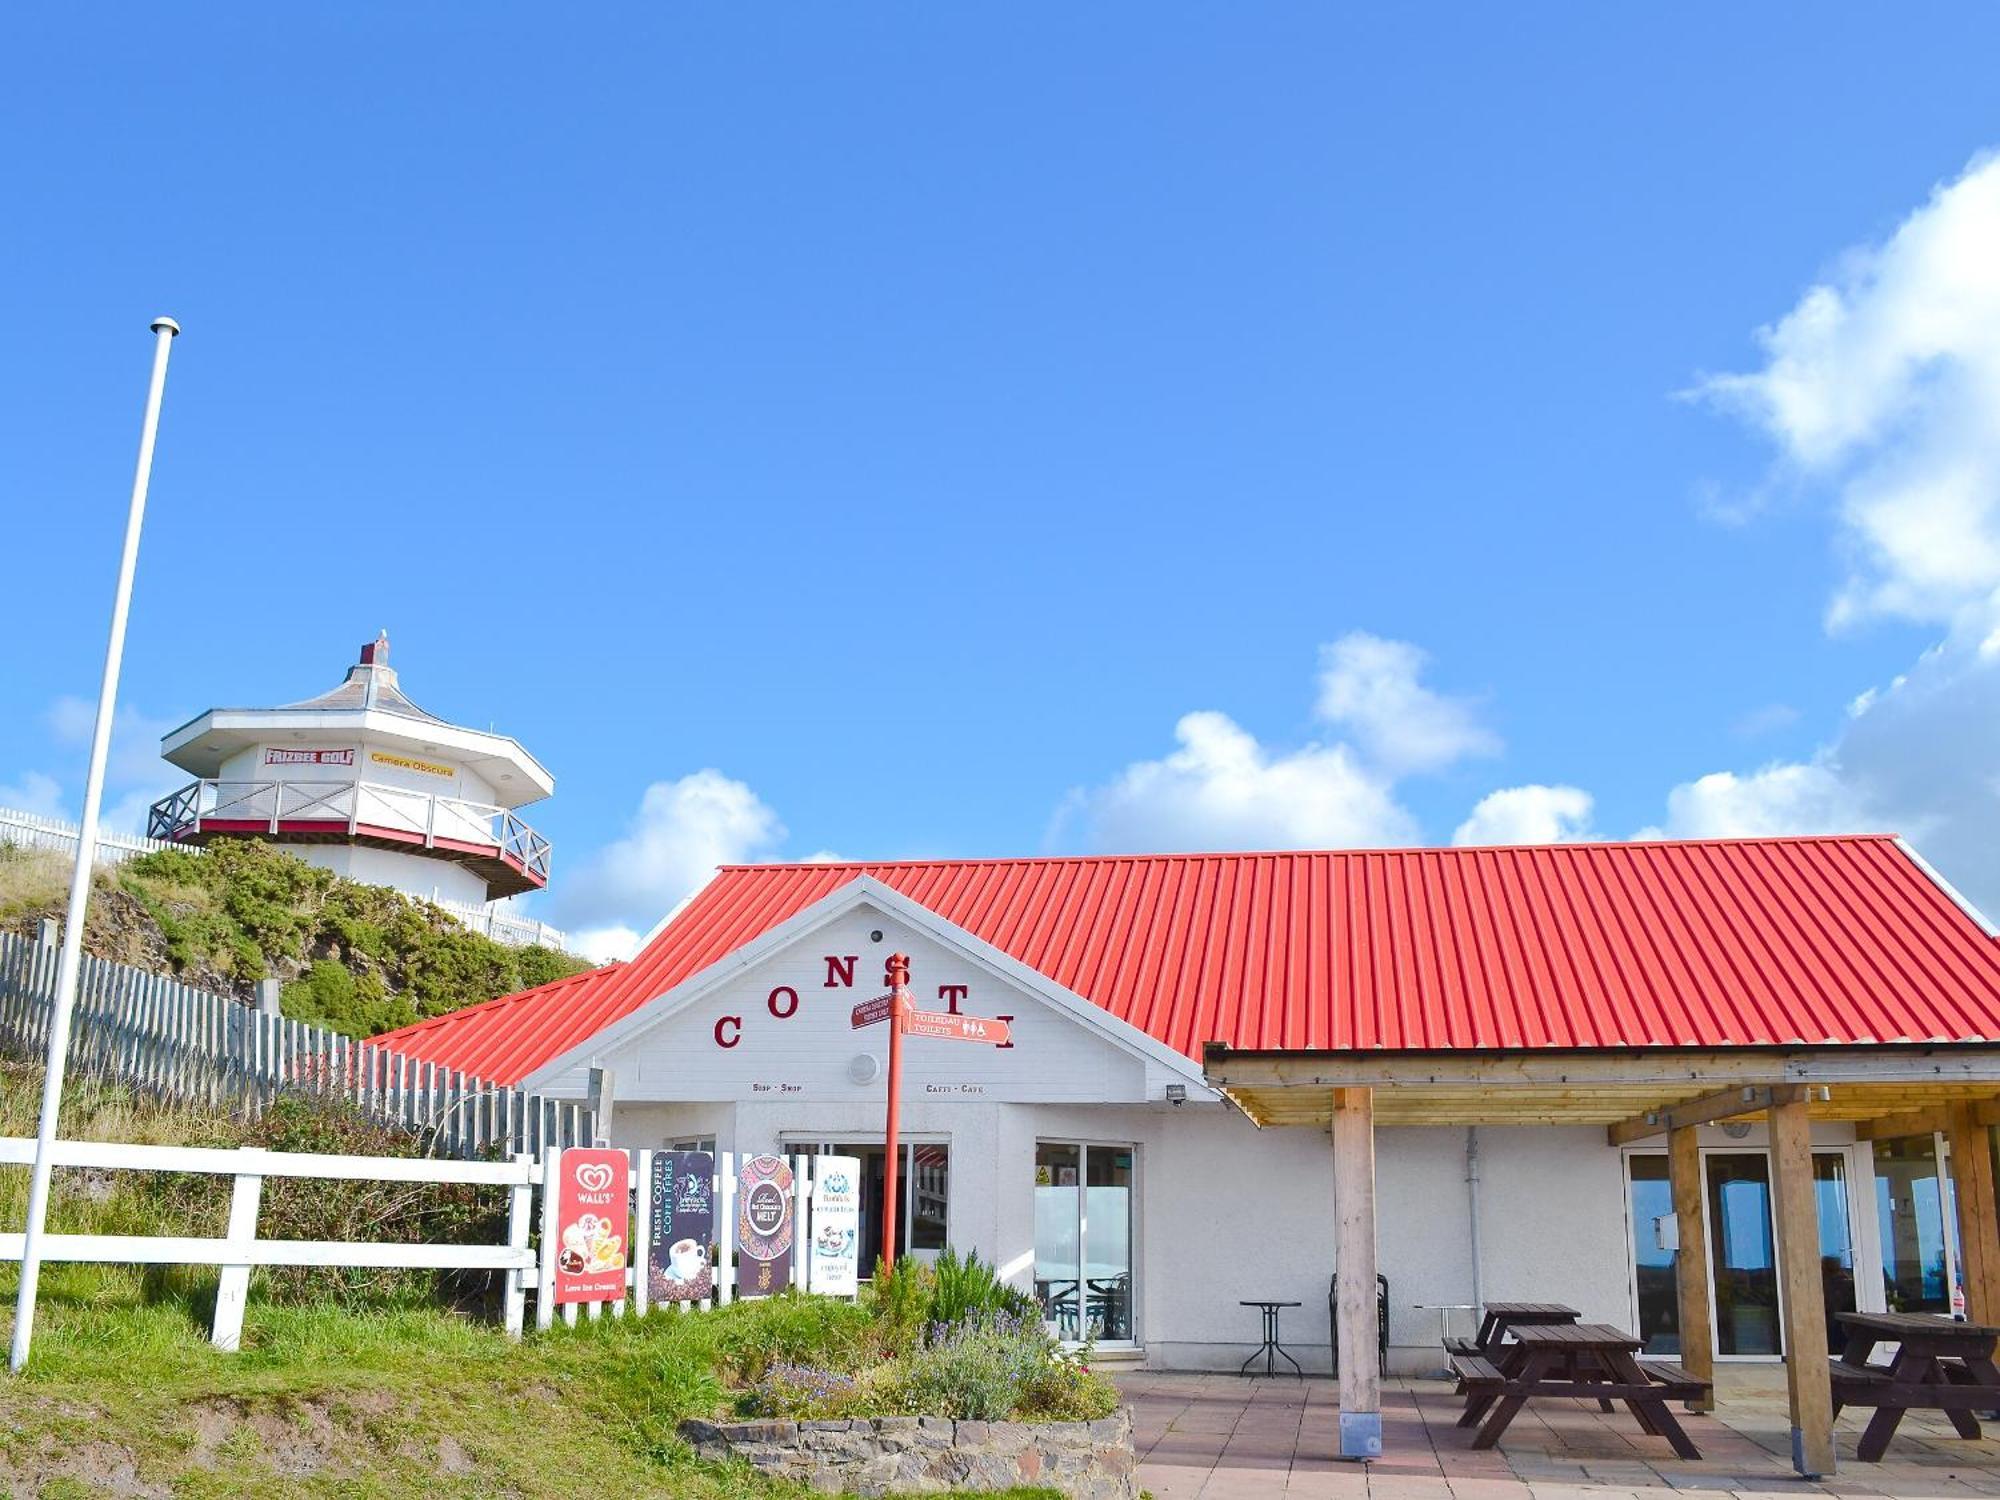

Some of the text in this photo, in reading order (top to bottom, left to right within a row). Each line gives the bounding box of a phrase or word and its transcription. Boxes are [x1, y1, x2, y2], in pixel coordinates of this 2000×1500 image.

[266, 749, 354, 765] FRIZBEE GOLF
[371, 752, 454, 777] Camera Obscura
[914, 1013, 960, 1027] TOILEDAU
[914, 1023, 952, 1036] TOILETS
[577, 1193, 611, 1204] WALL'S
[653, 1160, 662, 1246] FRESH COFFEE
[663, 1198, 672, 1234] COFFI
[756, 1211, 777, 1221] MELT
